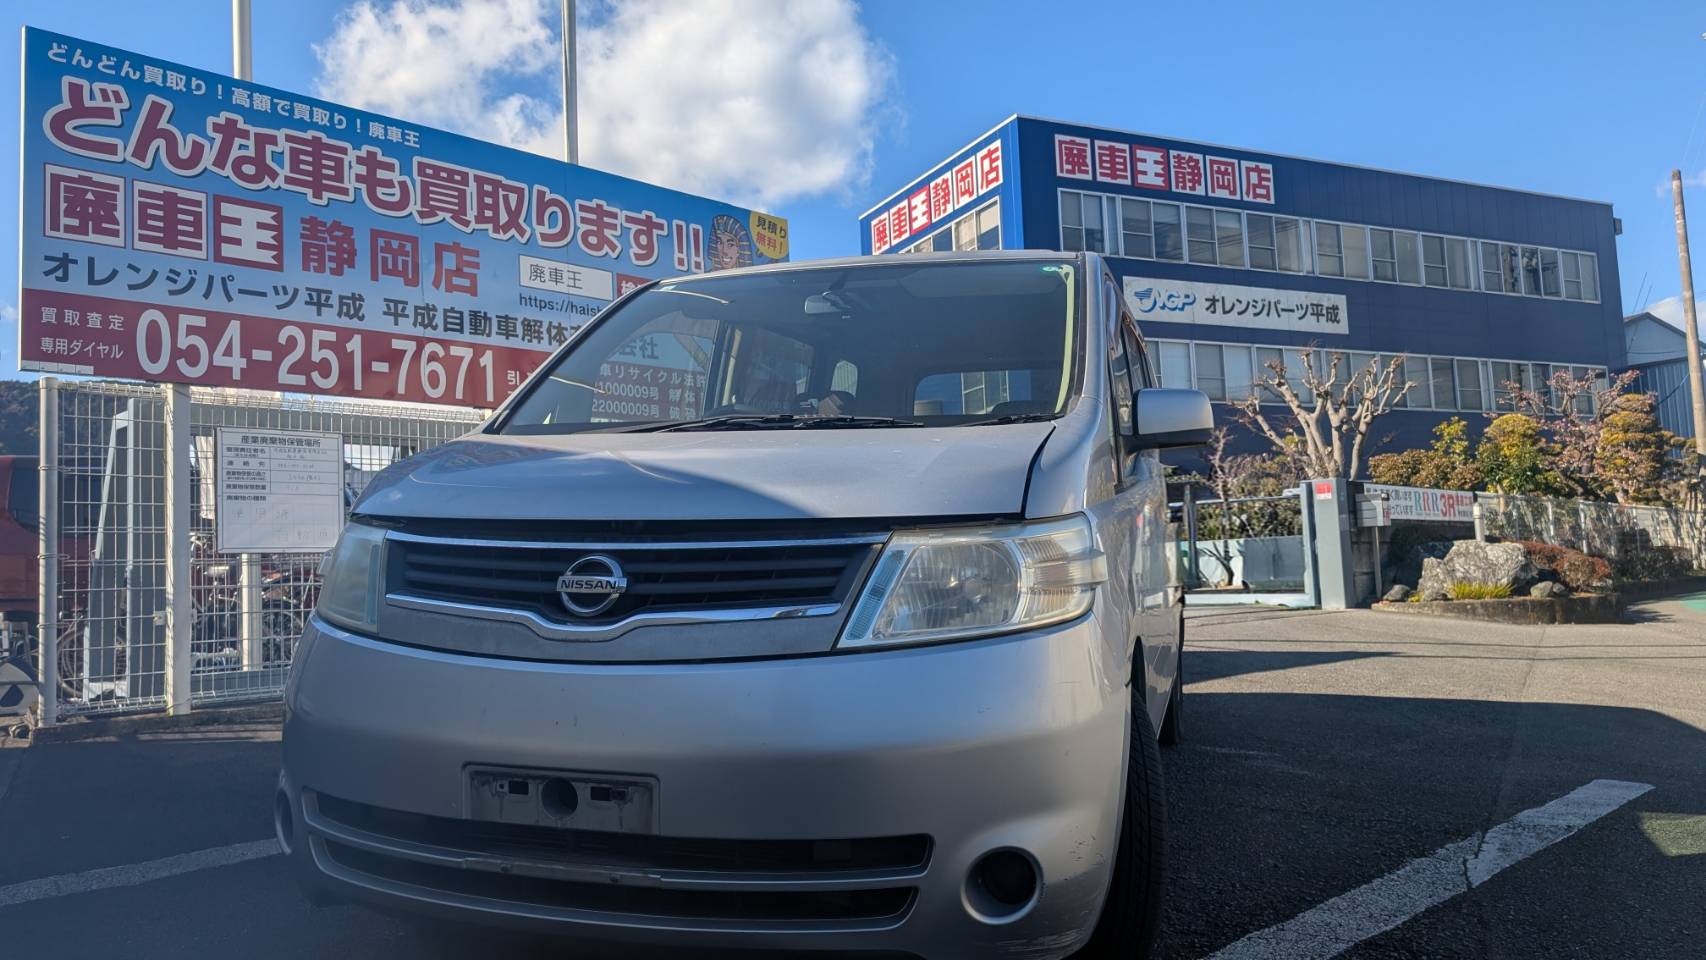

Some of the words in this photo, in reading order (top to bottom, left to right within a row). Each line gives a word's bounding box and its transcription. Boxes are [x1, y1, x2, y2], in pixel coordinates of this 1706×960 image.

[1058, 136, 1272, 204] 廃車王静岡店
[873, 145, 1001, 255] 廃車王静岡店
[43, 252, 365, 322] オレンジパーツ平成
[529, 263, 583, 290] 廃車王
[41, 306, 125, 331] 買取査定
[1204, 296, 1341, 325] オレンジパーツ平成
[40, 337, 124, 359] 専用ダイヤル
[136, 308, 494, 403] 054-251-7671
[560, 579, 617, 590] NISSAN
